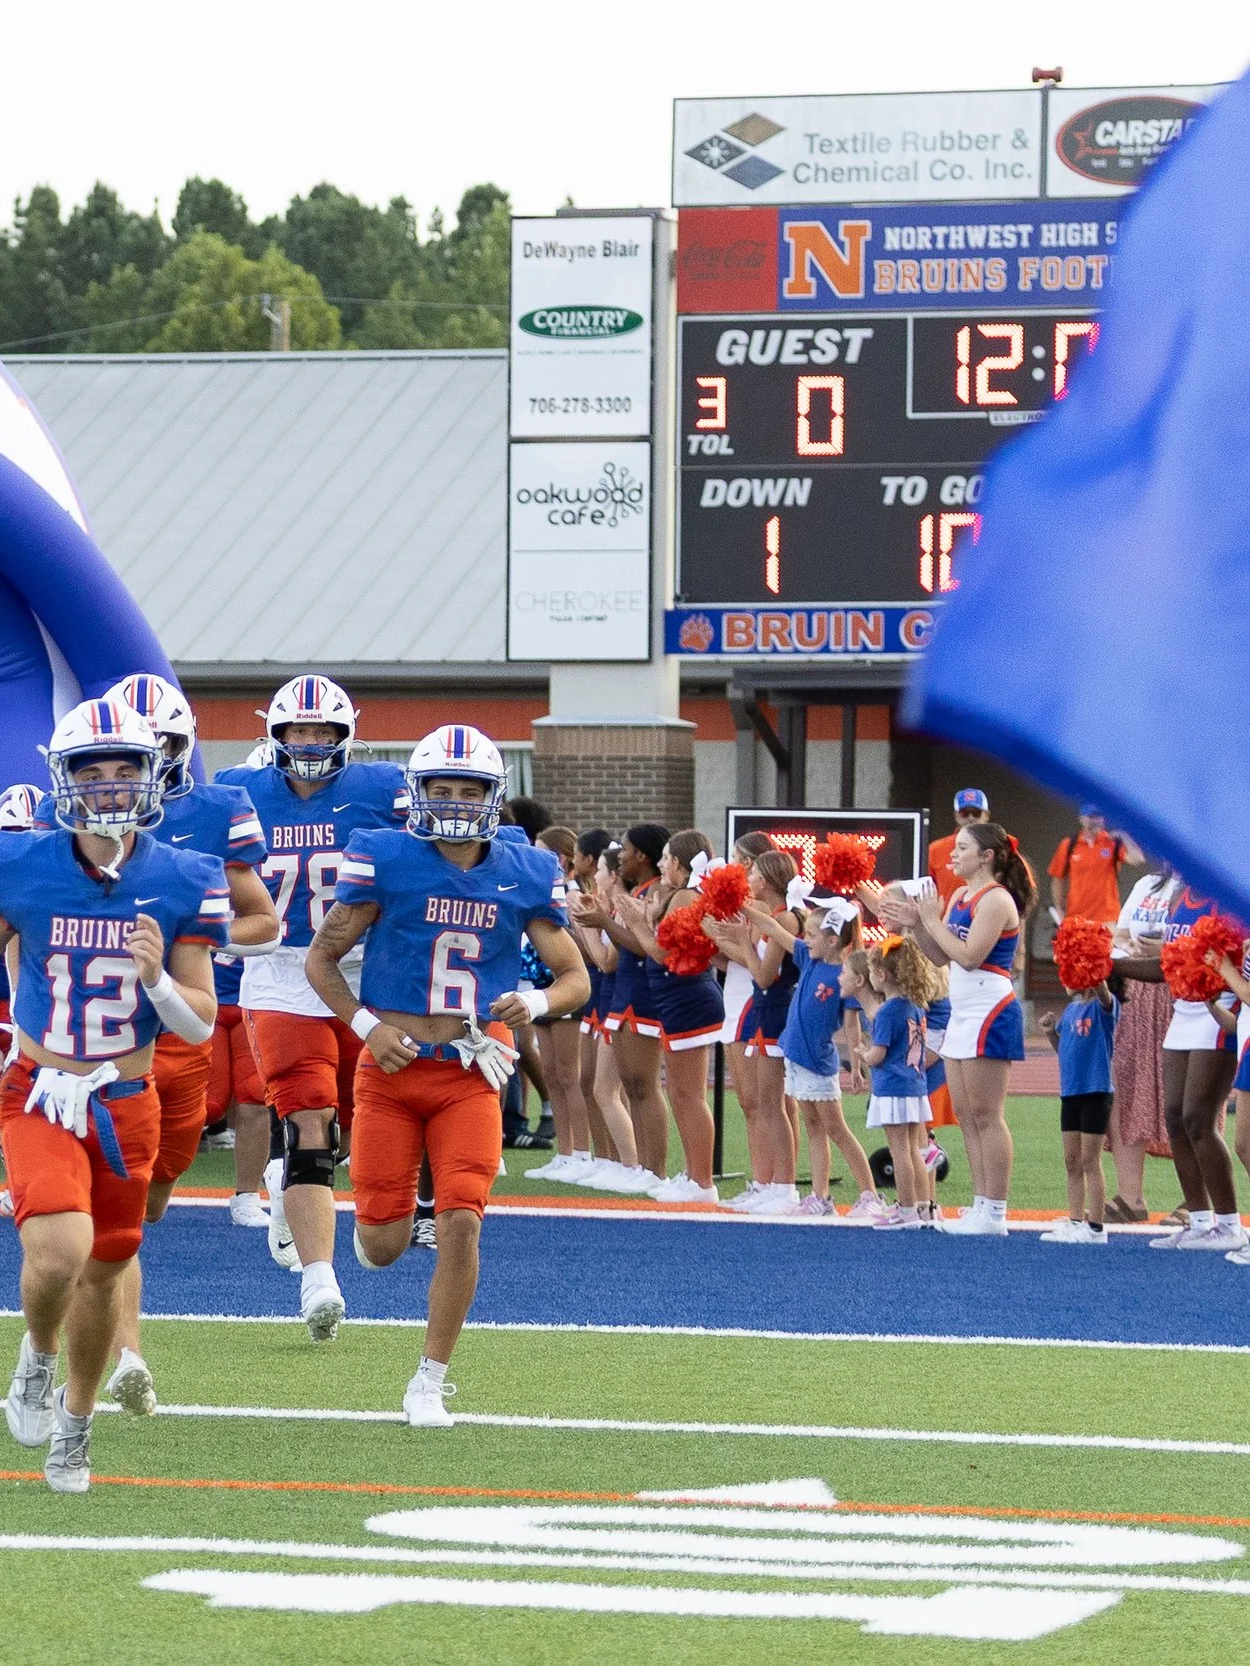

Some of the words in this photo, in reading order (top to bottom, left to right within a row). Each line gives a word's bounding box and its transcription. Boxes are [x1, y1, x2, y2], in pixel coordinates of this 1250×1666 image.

[803, 131, 892, 155] Textile
[901, 129, 1002, 152] Rubber
[1010, 128, 1029, 150] &
[793, 160, 919, 184] Chemical
[928, 159, 974, 182] Co.
[984, 157, 1033, 180] Inc.
[523, 239, 597, 262] DeWayne
[602, 239, 640, 258] Blair
[883, 223, 1034, 251] NORTHWEST
[1040, 221, 1100, 248] HIGH
[783, 220, 872, 300] N
[873, 256, 1007, 294] BRUINS
[1017, 254, 1110, 293] FOOT
[532, 310, 629, 329] COUNTRY
[714, 327, 875, 367] GUEST
[529, 396, 633, 414] 706-278-3300
[695, 376, 727, 429] 3
[796, 374, 845, 456] 0
[686, 433, 736, 457] TOL
[516, 481, 644, 505] oakwood
[700, 477, 813, 508] DOWN
[880, 474, 928, 505] TO
[547, 504, 606, 526] cafe
[765, 515, 781, 594] 1
[514, 589, 644, 613] CHEROKEE
[721, 610, 886, 653] BRUIN
[296, 712, 323, 720] Riddell
[93, 735, 125, 744] Riddell
[272, 822, 336, 849] BRUINS
[261, 851, 344, 938] 78
[424, 897, 498, 929] BRUINS
[50, 915, 135, 949] BRUINS
[428, 930, 482, 1017] 6
[43, 952, 140, 1058] 12
